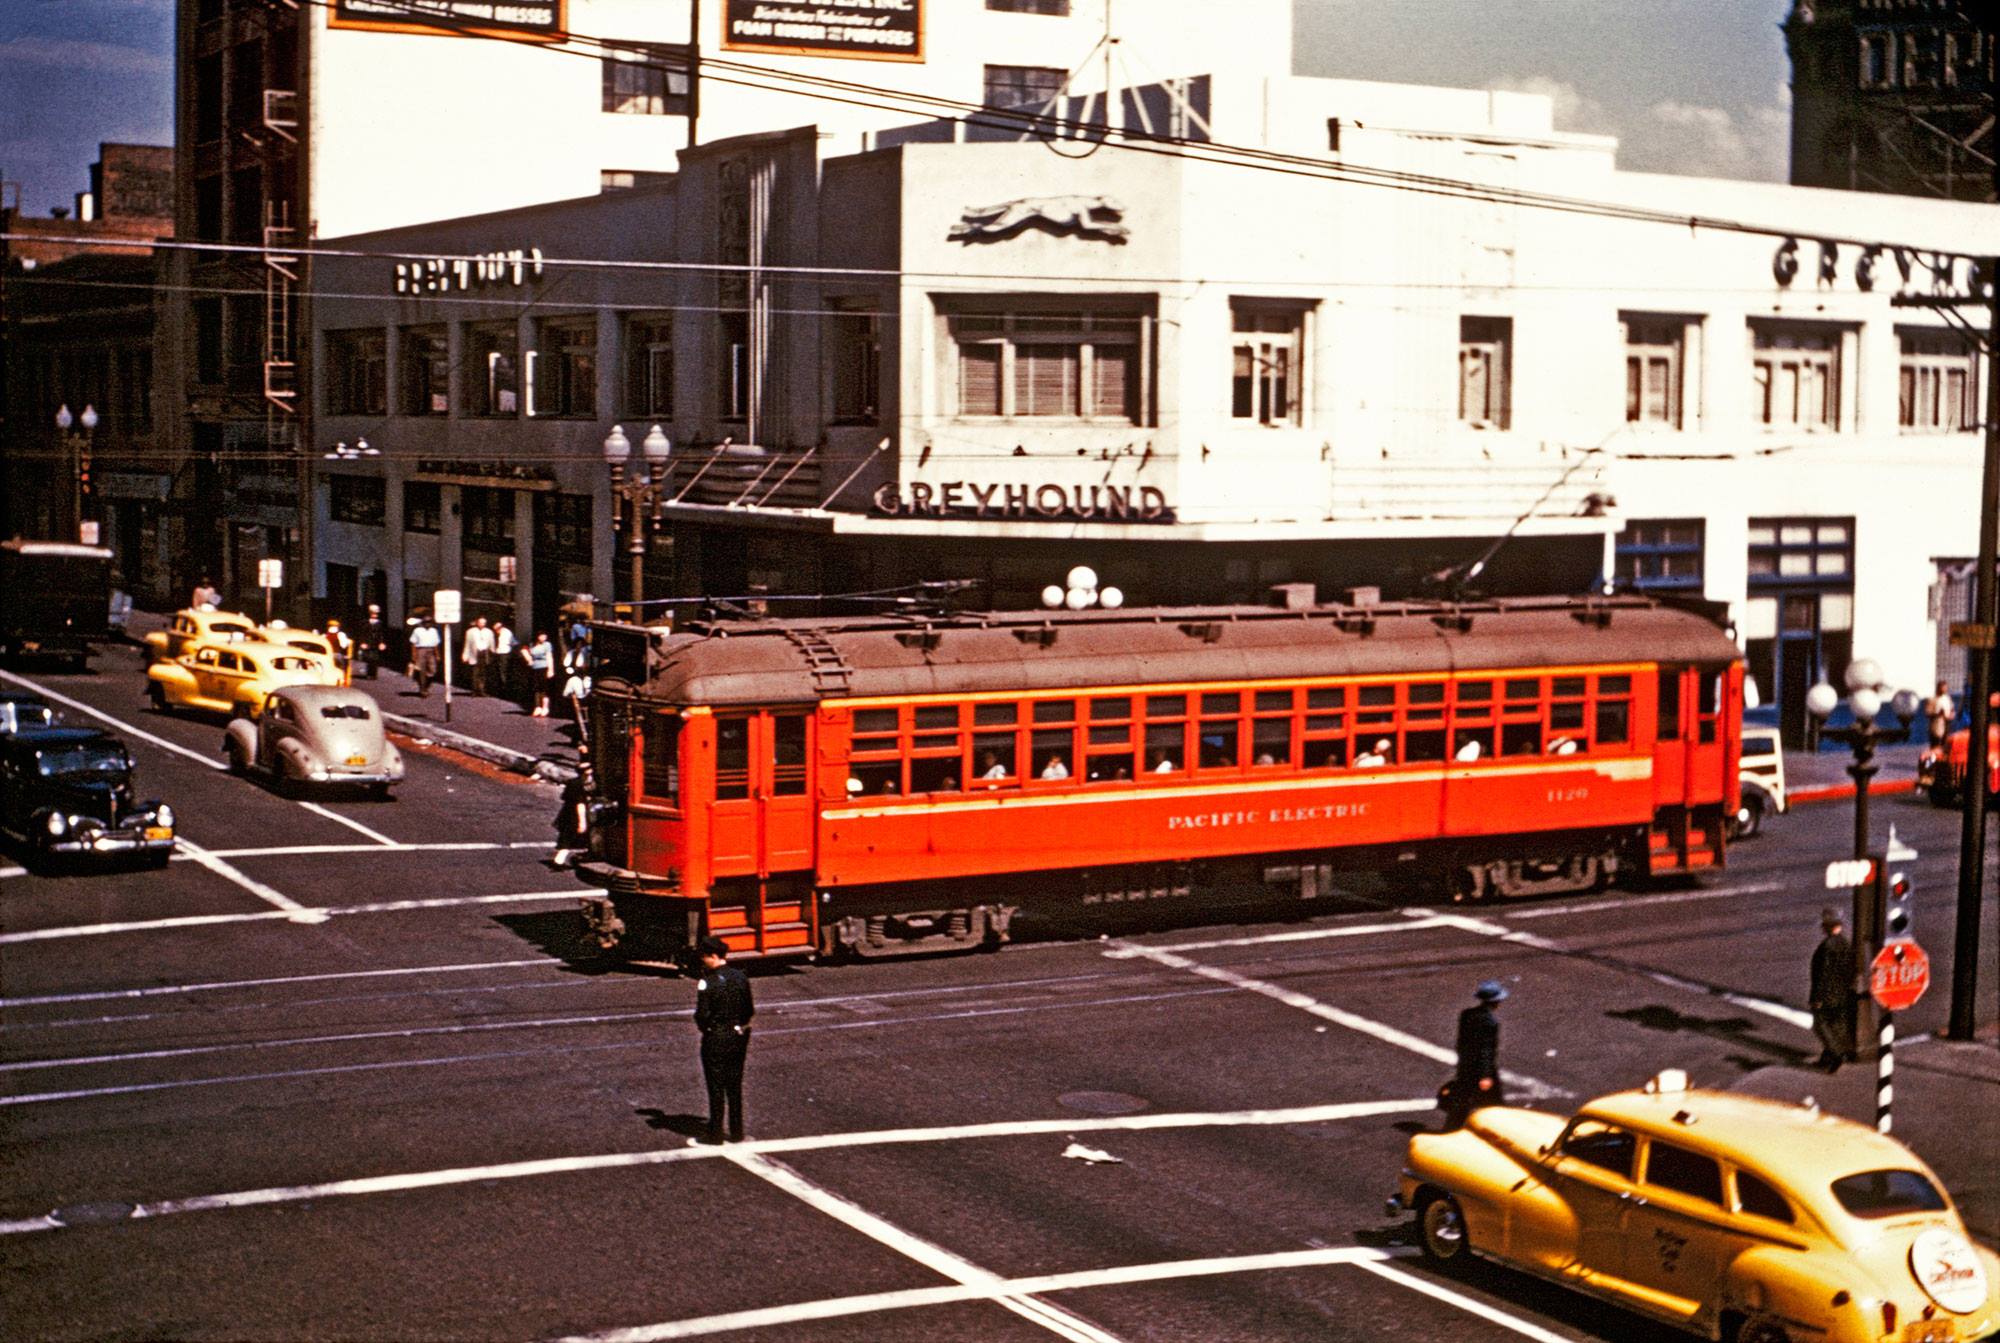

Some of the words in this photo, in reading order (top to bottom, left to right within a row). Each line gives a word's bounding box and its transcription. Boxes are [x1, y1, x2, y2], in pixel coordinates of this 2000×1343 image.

[494, 6, 553, 25] DRESSES
[733, 20, 773, 36] FOAM
[842, 27, 915, 46] PURPOSES
[873, 481, 1167, 519] GREYHOUND
[1168, 811, 1260, 830] PACIFIC
[1269, 802, 1372, 823] ELECTRIC
[1875, 957, 1925, 989] STOP
